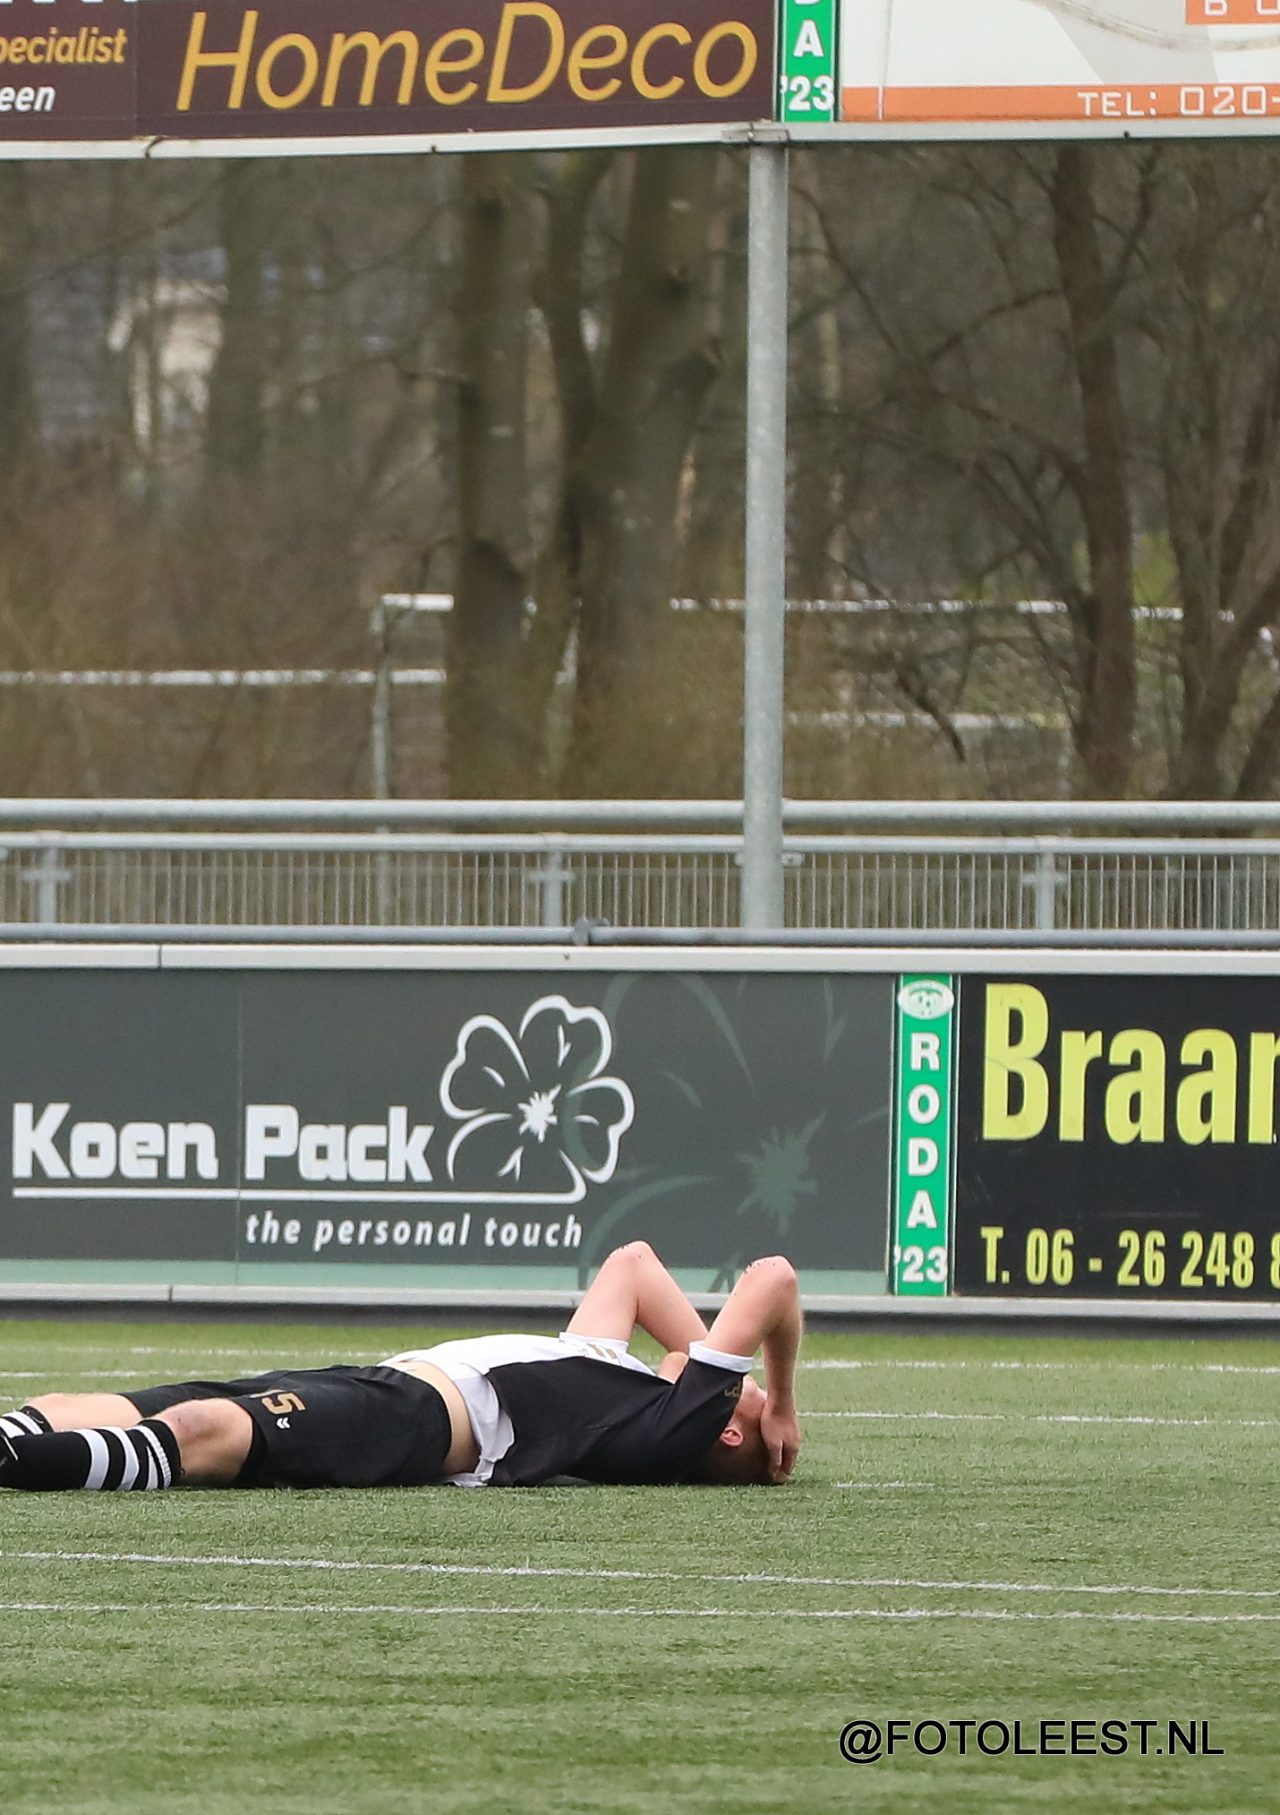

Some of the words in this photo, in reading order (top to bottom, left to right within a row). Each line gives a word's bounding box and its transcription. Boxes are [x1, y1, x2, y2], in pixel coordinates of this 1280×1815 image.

[176, 1, 757, 111] HomeDeco
[1077, 91, 1157, 116] TEL:
[12, 1102, 219, 1180] Koen
[244, 1104, 435, 1182] Pack
[245, 1200, 302, 1245] the
[312, 1202, 471, 1253] personal
[483, 1204, 584, 1248] touch
[980, 1226, 1011, 1285] T.
[1025, 1227, 1075, 1286] 06
[1116, 1229, 1167, 1287] 26
[1180, 1231, 1255, 1288] 248
